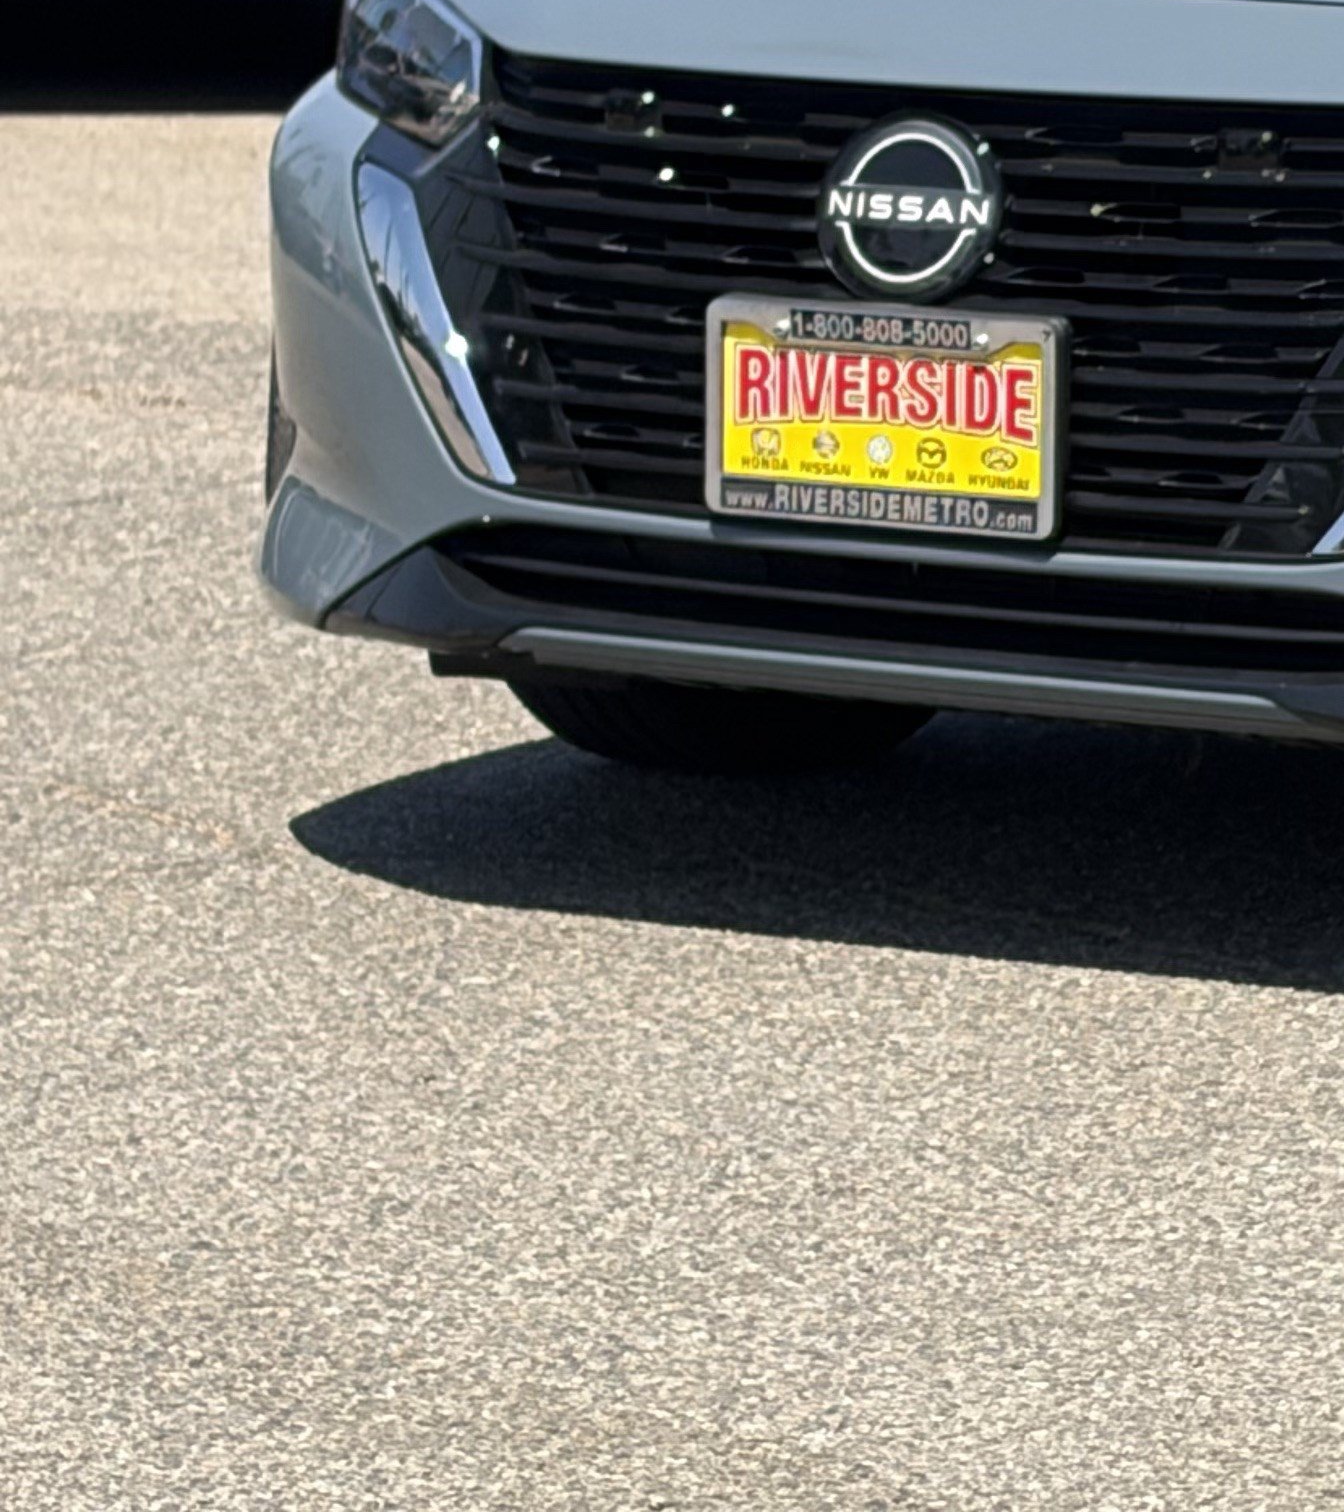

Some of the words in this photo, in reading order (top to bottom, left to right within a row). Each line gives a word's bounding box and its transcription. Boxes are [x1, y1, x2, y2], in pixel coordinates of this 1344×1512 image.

[828, 189, 989, 225] NISSAN
[792, 312, 968, 347] 1-800-808-5000
[737, 347, 1036, 445] RIVERSIDE
[741, 456, 789, 472] HONDA
[799, 461, 851, 477] NISSAN
[869, 467, 890, 480] VW
[905, 470, 955, 485] MAZDA
[968, 474, 1030, 491] HYUNDAI
[725, 485, 1033, 532] www.RIVERSIDEMETRO.com
